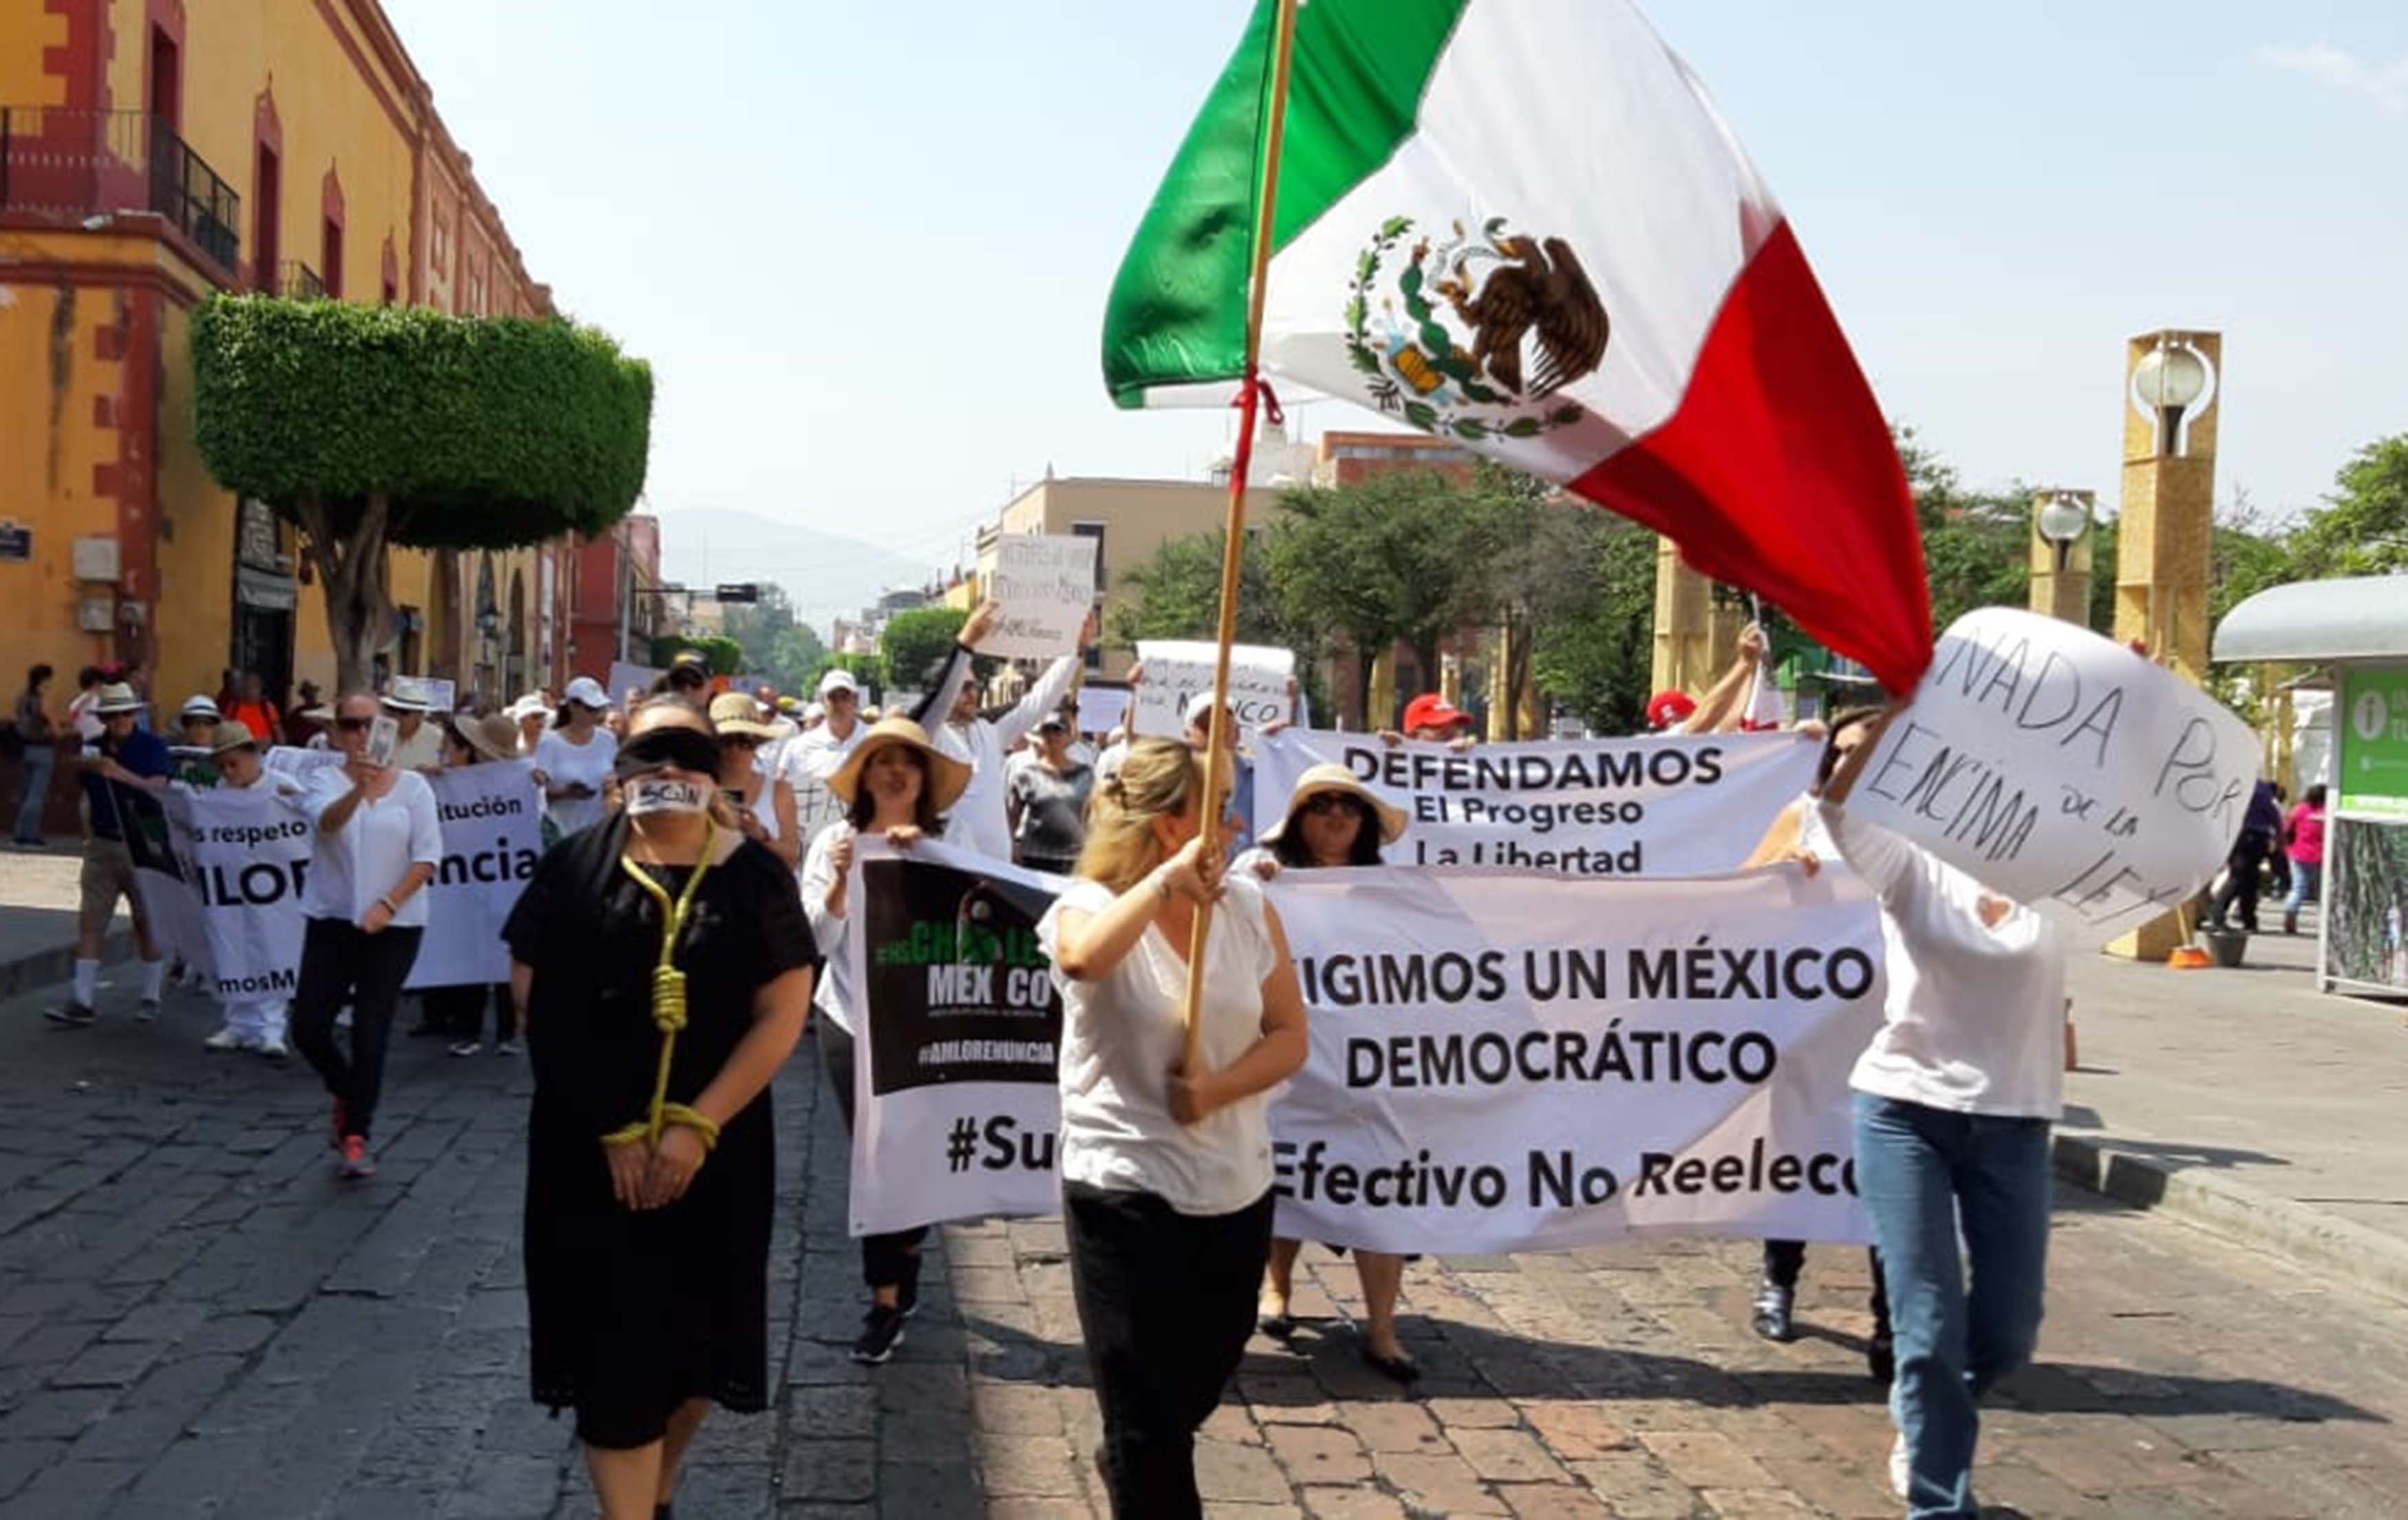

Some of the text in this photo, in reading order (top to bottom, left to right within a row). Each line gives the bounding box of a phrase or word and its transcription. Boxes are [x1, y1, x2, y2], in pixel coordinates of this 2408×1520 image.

[1935, 626, 2243, 839] NADA POR
[1344, 747, 1723, 791] DEFENDAMOS
[1865, 722, 2040, 862] ENCIMA
[2104, 806, 2140, 839] LA
[213, 822, 306, 848] respeto
[1415, 796, 1643, 833] El Progreso
[427, 836, 539, 886] ncia
[2052, 850, 2180, 925] LEY
[1291, 935, 1874, 1005] IGIMOS UN MÉXICO
[1346, 1017, 1777, 1089] DEMOCRÁTICO
[1273, 1141, 1507, 1209] Efectivo
[1527, 1150, 1618, 1208] No
